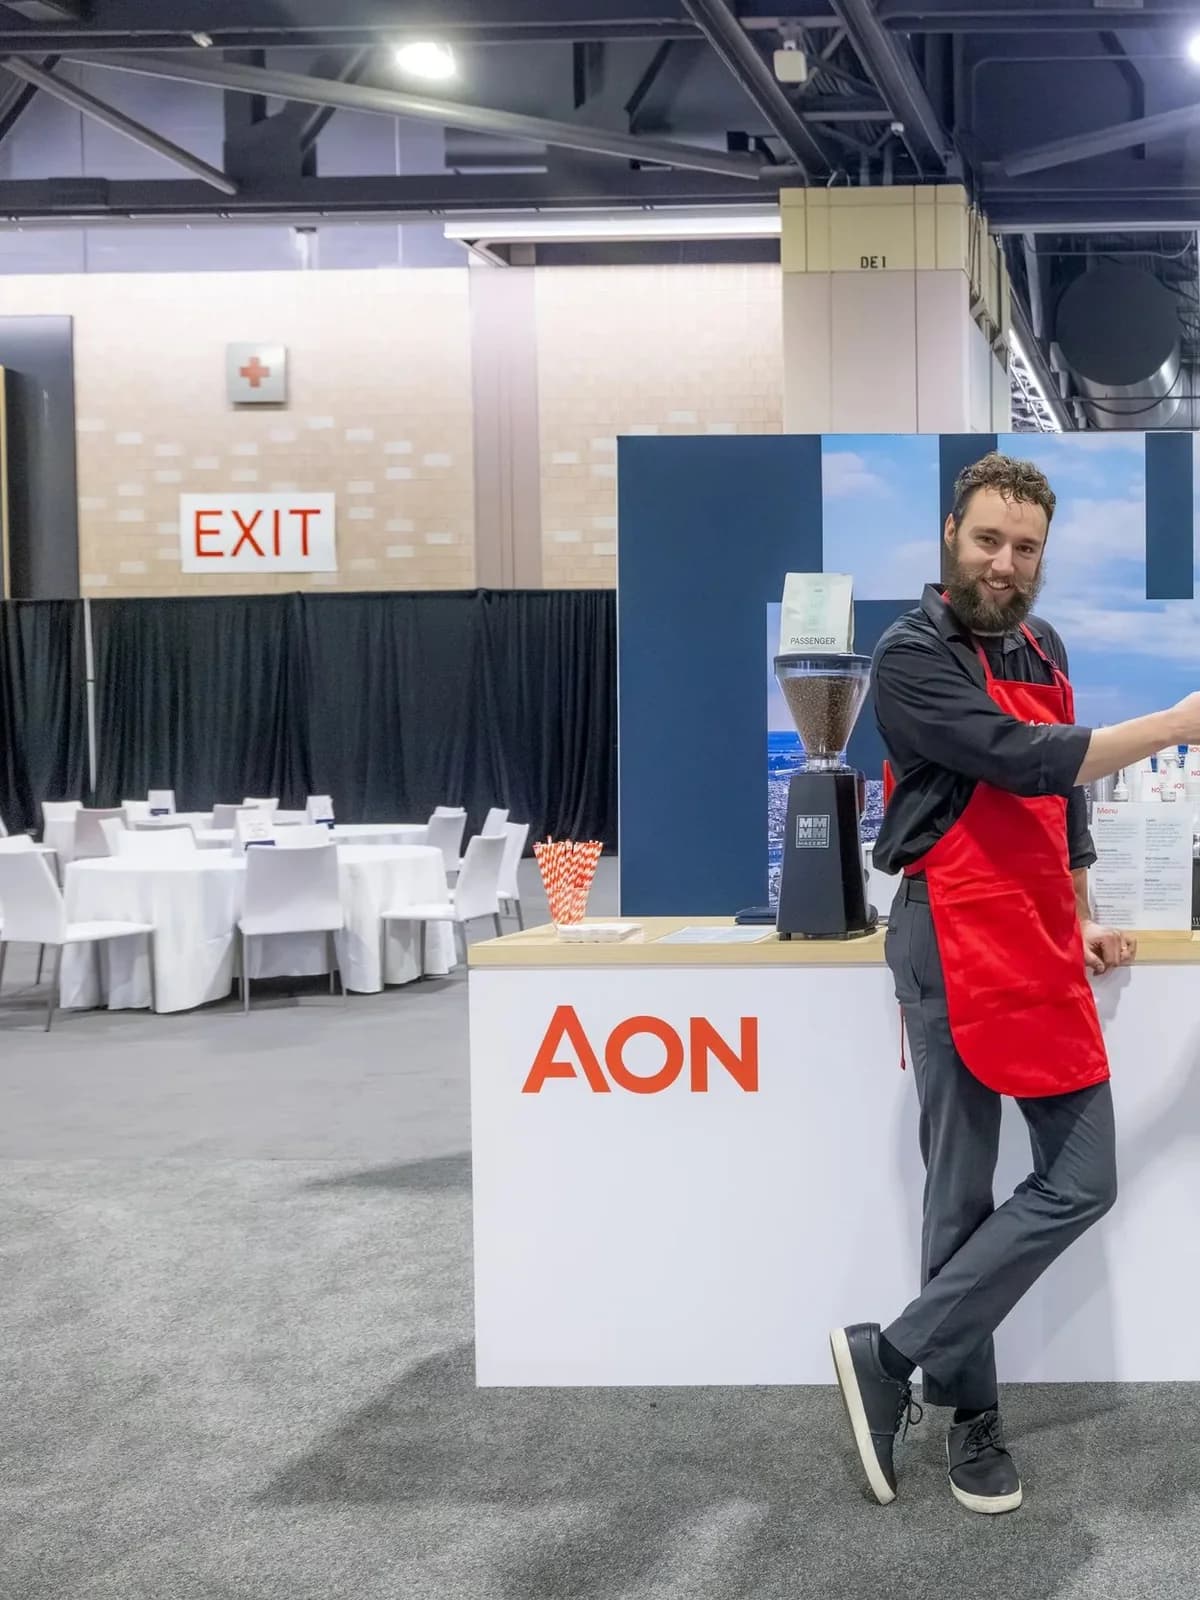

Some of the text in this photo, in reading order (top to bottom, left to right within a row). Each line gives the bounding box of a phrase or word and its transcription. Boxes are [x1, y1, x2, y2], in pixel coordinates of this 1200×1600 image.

[194, 508, 322, 558] EXIT
[790, 636, 837, 645] PASSENGER
[1096, 807, 1119, 815] Menu
[521, 1004, 760, 1095] AON
